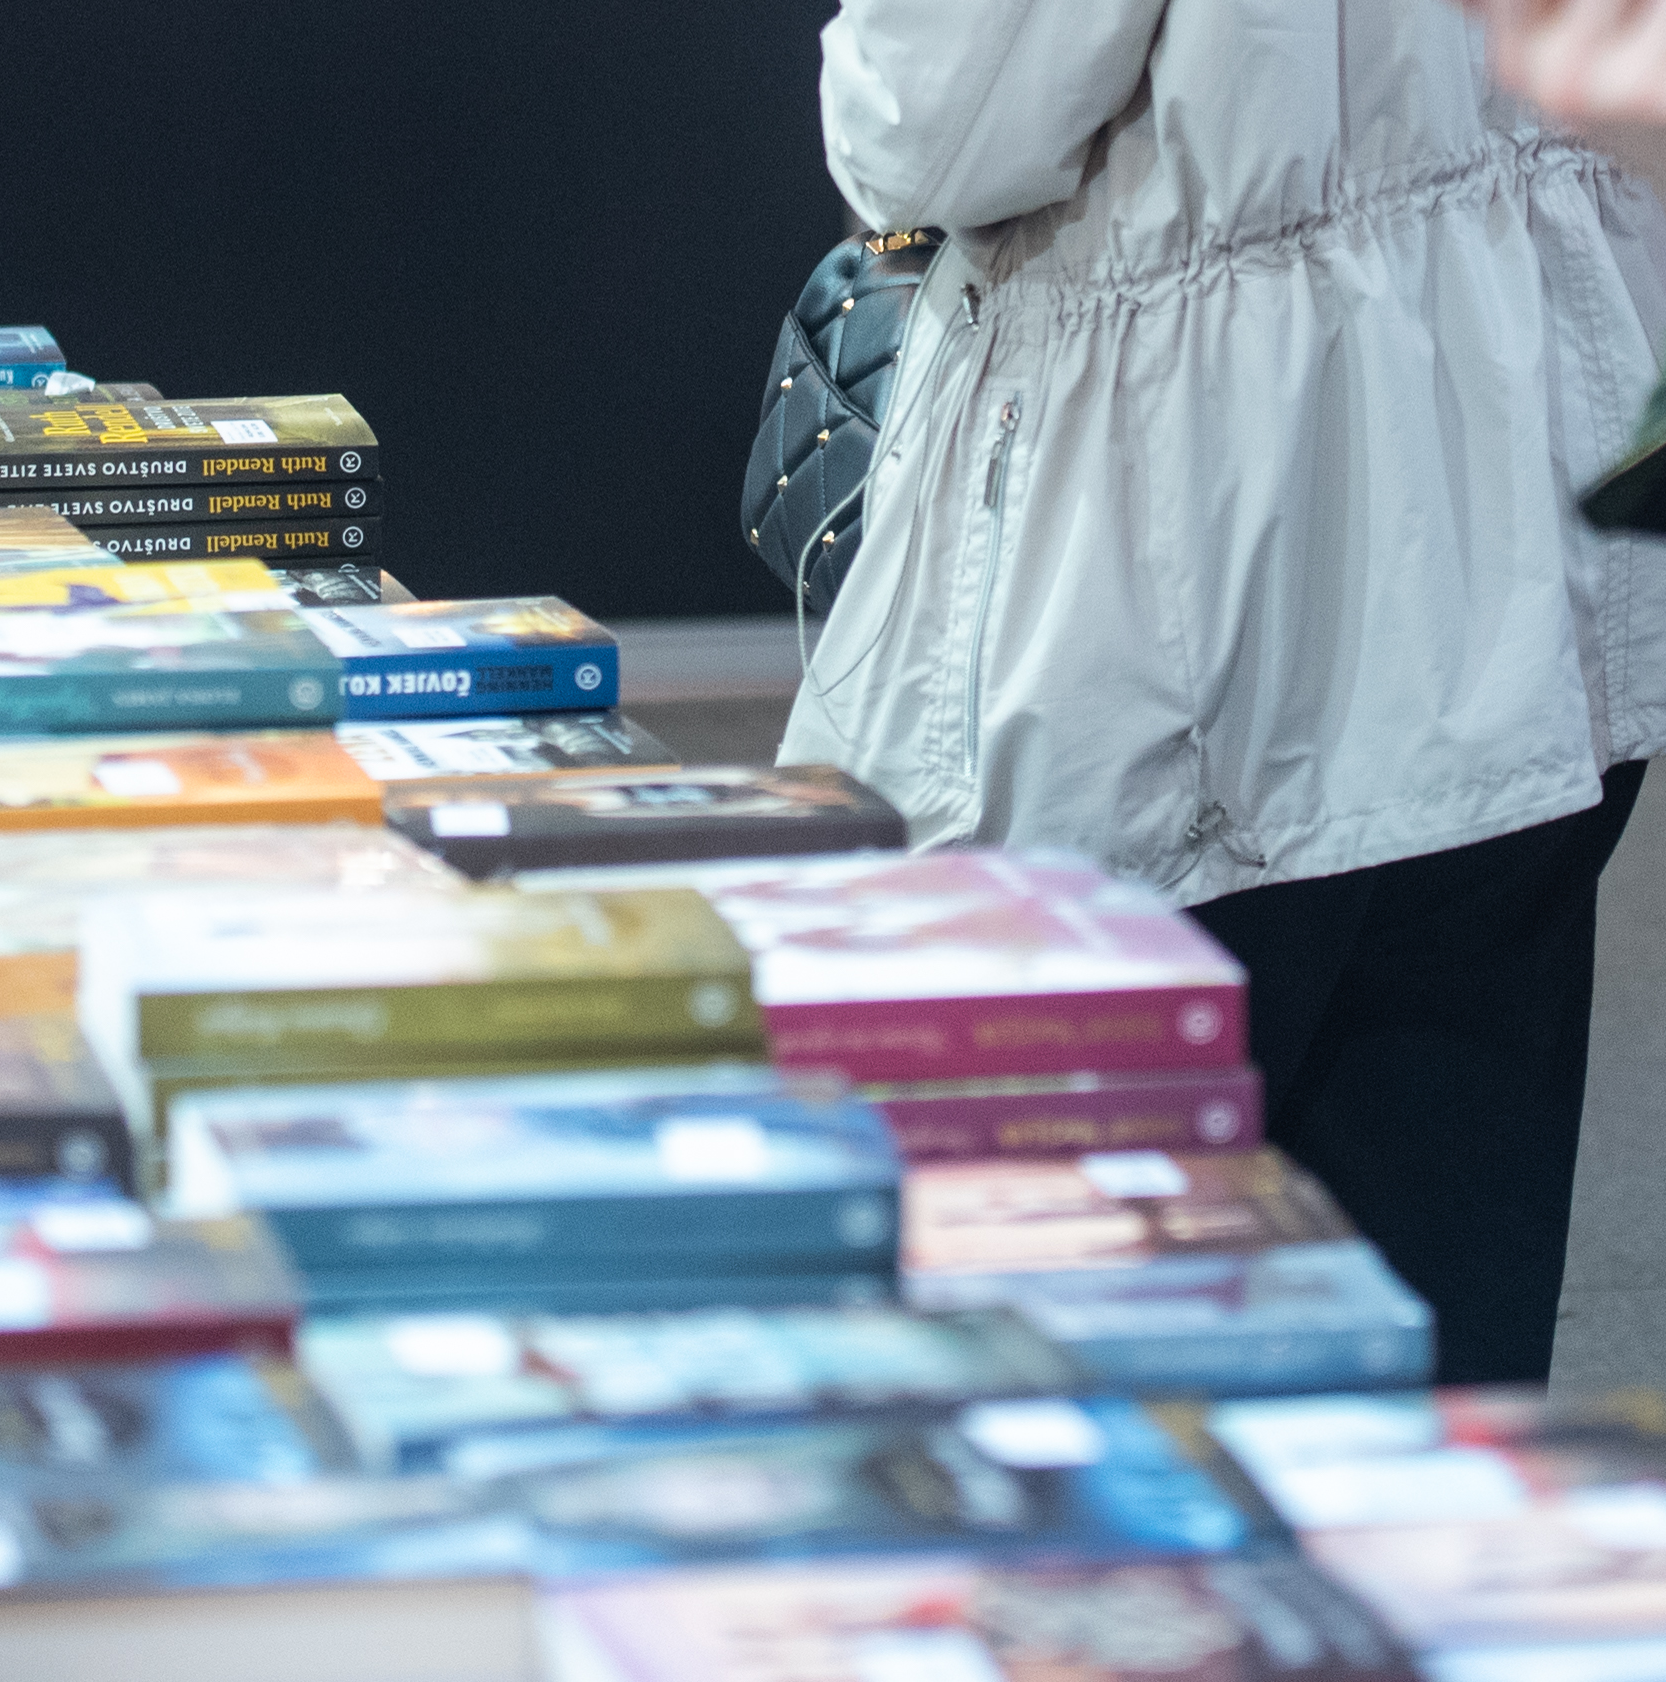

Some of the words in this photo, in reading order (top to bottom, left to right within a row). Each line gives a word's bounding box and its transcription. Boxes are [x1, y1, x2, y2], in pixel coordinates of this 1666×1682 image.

[0, 464, 38, 479] ZITE
[42, 462, 97, 478] SVETE
[102, 460, 188, 479] DRUŠTVO
[202, 457, 276, 476] Rendell
[280, 455, 328, 475] Ruth
[50, 500, 104, 516] SVETE
[109, 497, 194, 517] DRUŠTVO
[208, 493, 282, 513] Rendell
[286, 491, 333, 511] Ruth
[106, 536, 192, 556] DRUŠTVO
[206, 532, 279, 553] Rendell
[283, 530, 330, 550] Ruth
[385, 669, 472, 699] ČOVJEK
